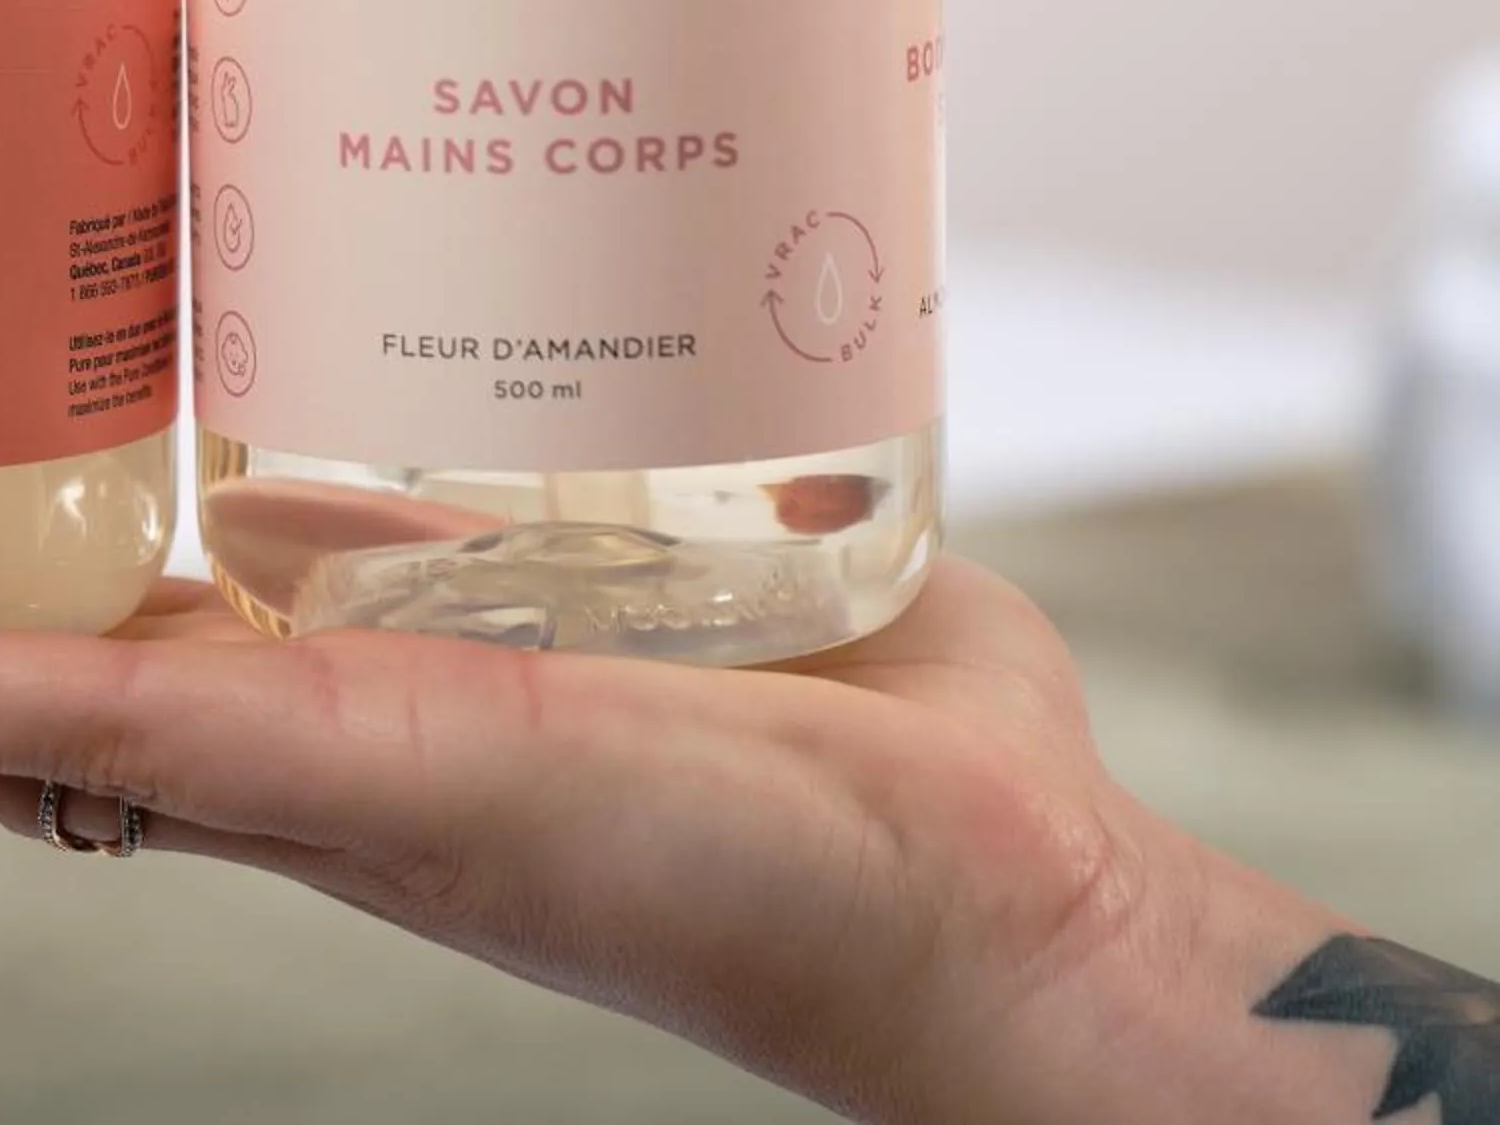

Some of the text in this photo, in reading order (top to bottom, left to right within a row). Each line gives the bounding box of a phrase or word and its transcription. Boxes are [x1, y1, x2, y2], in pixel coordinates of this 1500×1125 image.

[433, 77, 634, 116] SAVON
[338, 132, 739, 175] MAINS CORPS
[764, 209, 820, 280] VRAC
[382, 334, 697, 361] FLEUR D'AMANDIER
[840, 295, 883, 363] BULK
[494, 381, 581, 399] 500 ml
